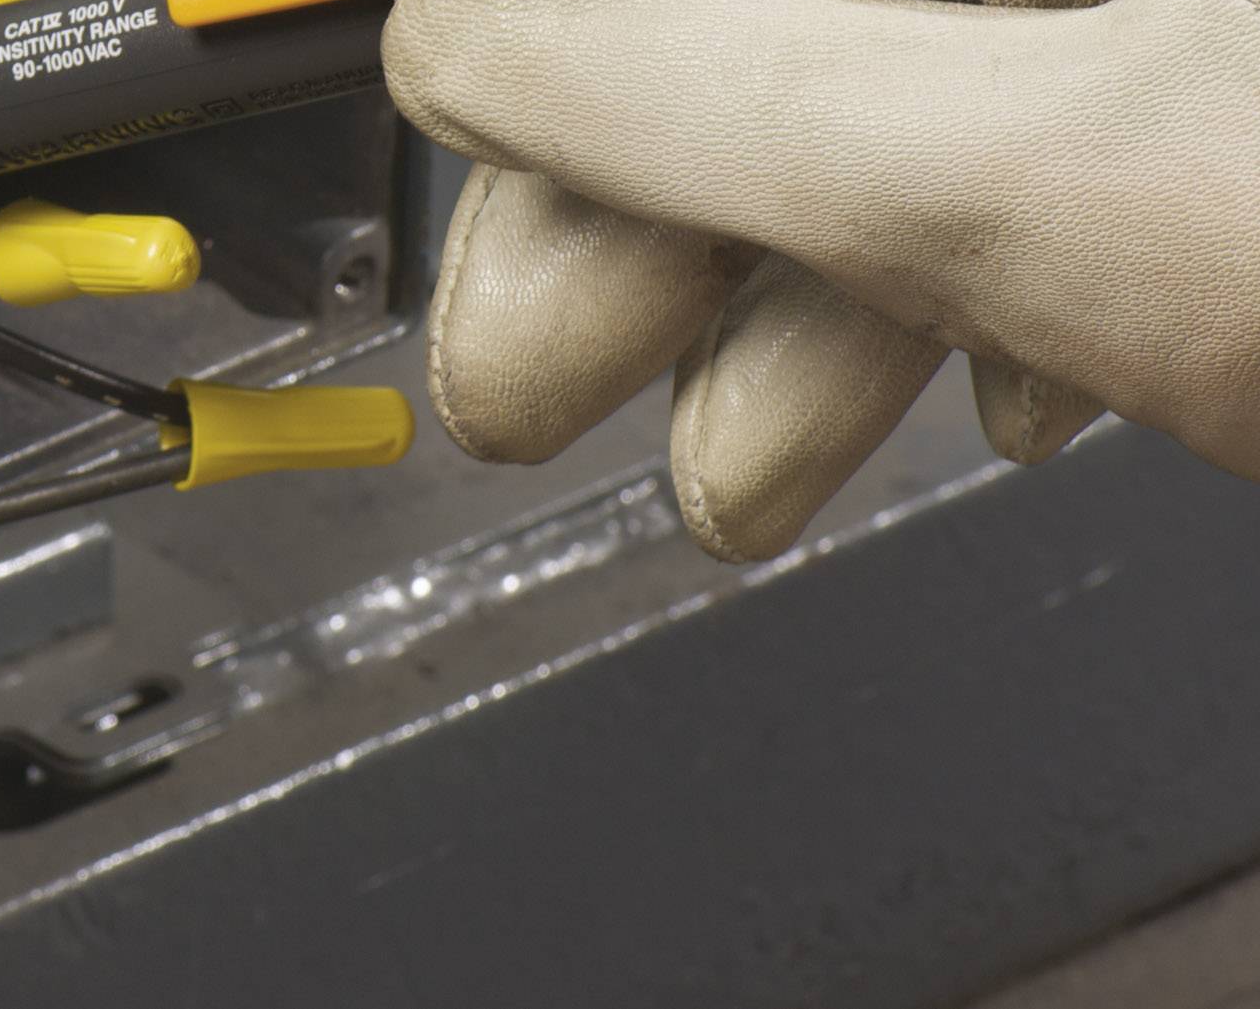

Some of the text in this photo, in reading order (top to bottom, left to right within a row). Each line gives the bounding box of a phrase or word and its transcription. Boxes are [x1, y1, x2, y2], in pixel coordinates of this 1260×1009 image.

[68, 1, 109, 24] 1000
[90, 8, 158, 37] RANGE
[12, 38, 123, 82] 90-1000 VAC
